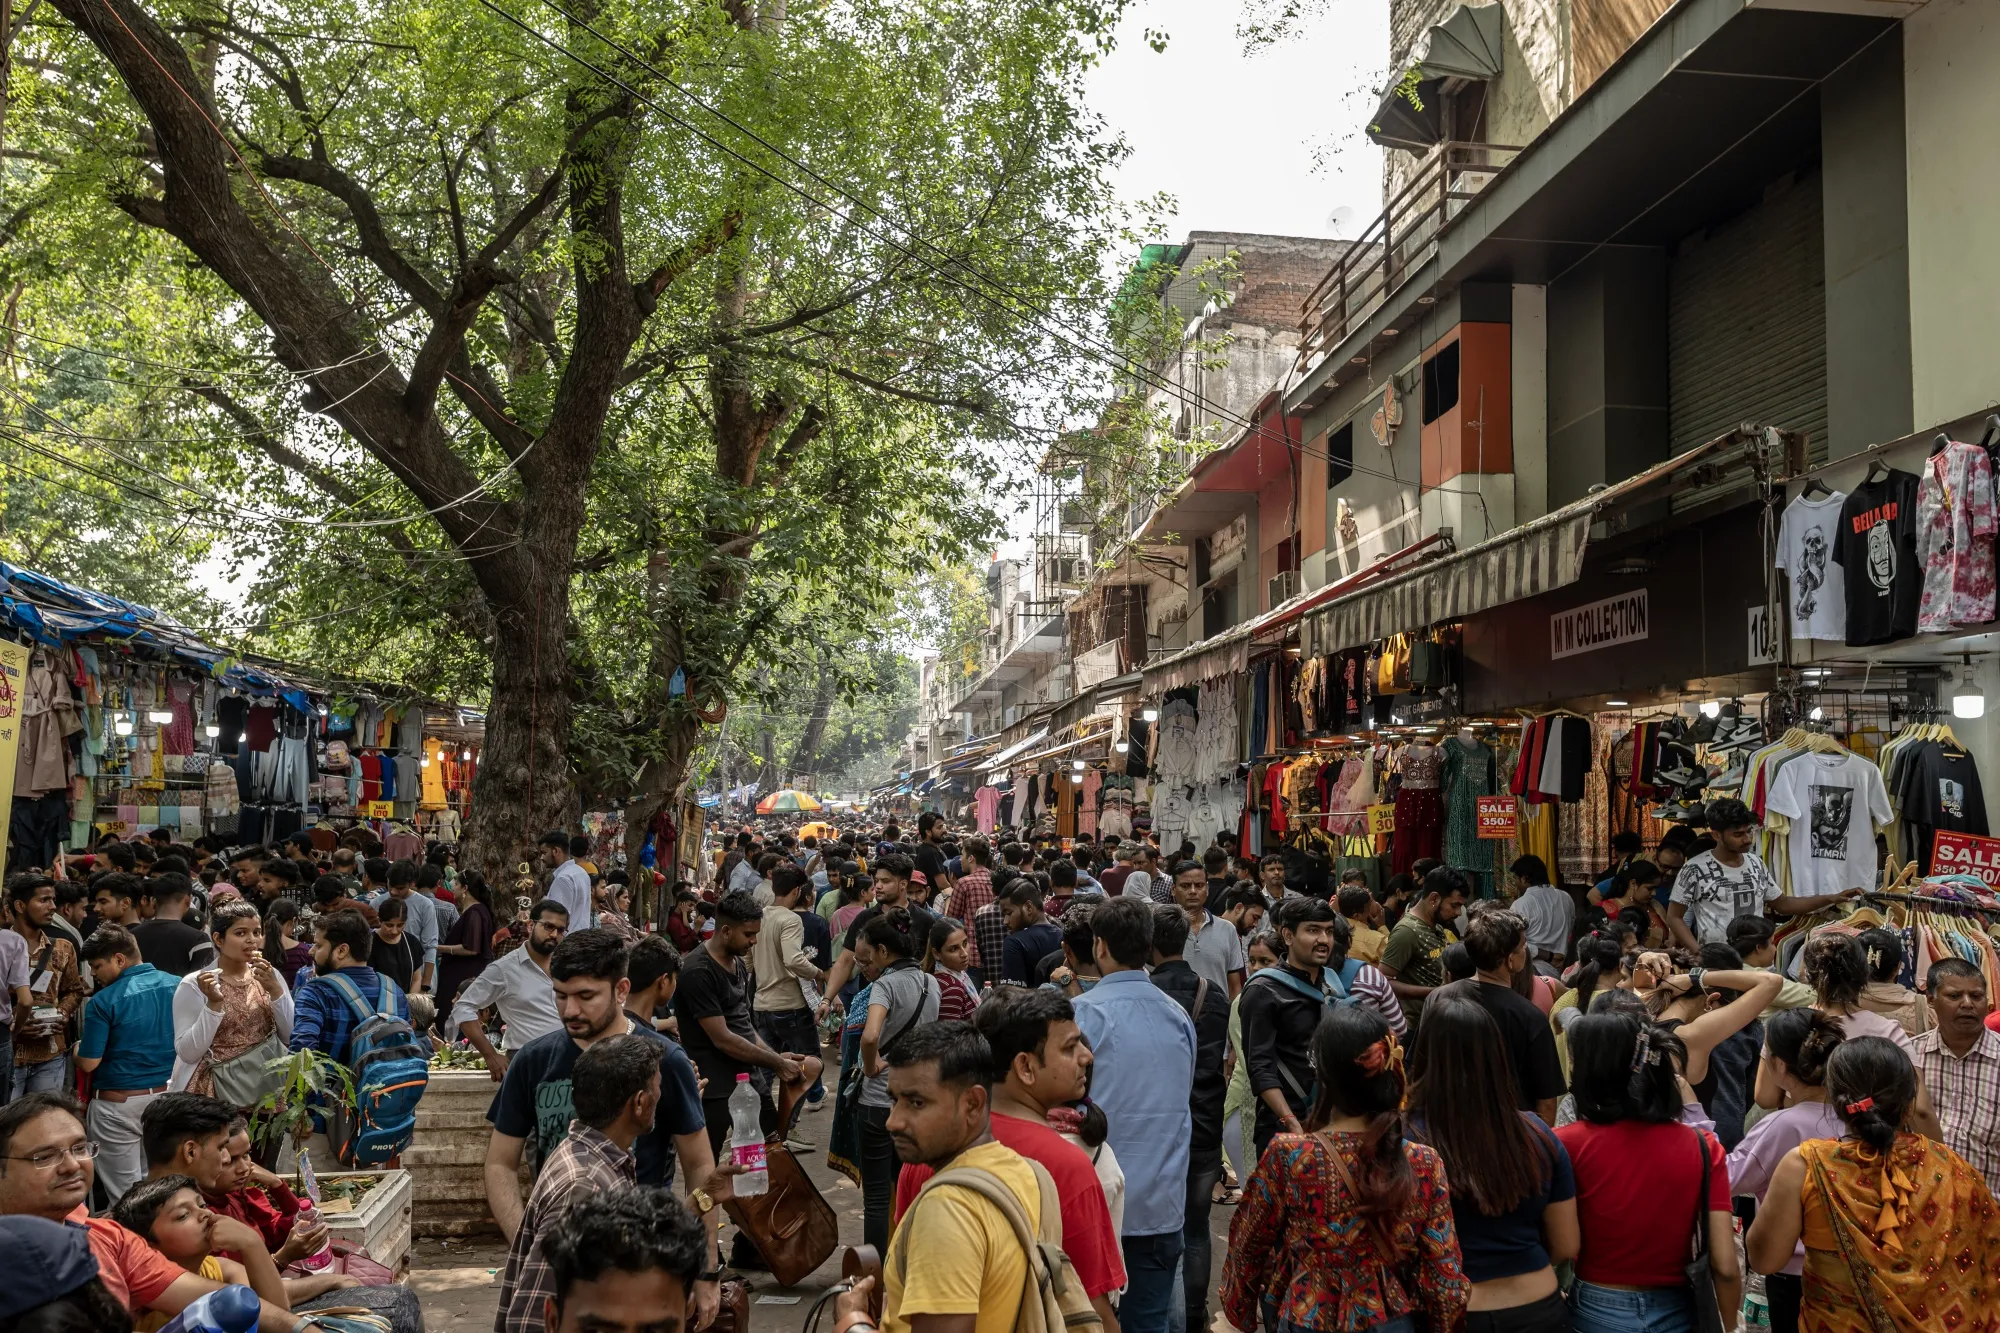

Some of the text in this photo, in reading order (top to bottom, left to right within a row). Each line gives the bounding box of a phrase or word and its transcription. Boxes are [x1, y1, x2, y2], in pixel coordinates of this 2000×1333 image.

[1852, 507, 1880, 534] BELLA
[1554, 594, 1646, 653] M M COLLECTION
[1479, 804, 1514, 813] SALE
[106, 821, 125, 831] 350
[1482, 817, 1512, 826] 350/-
[1937, 845, 2000, 869] SALE
[1934, 863, 1957, 875] 350
[537, 1084, 573, 1109] CUST
